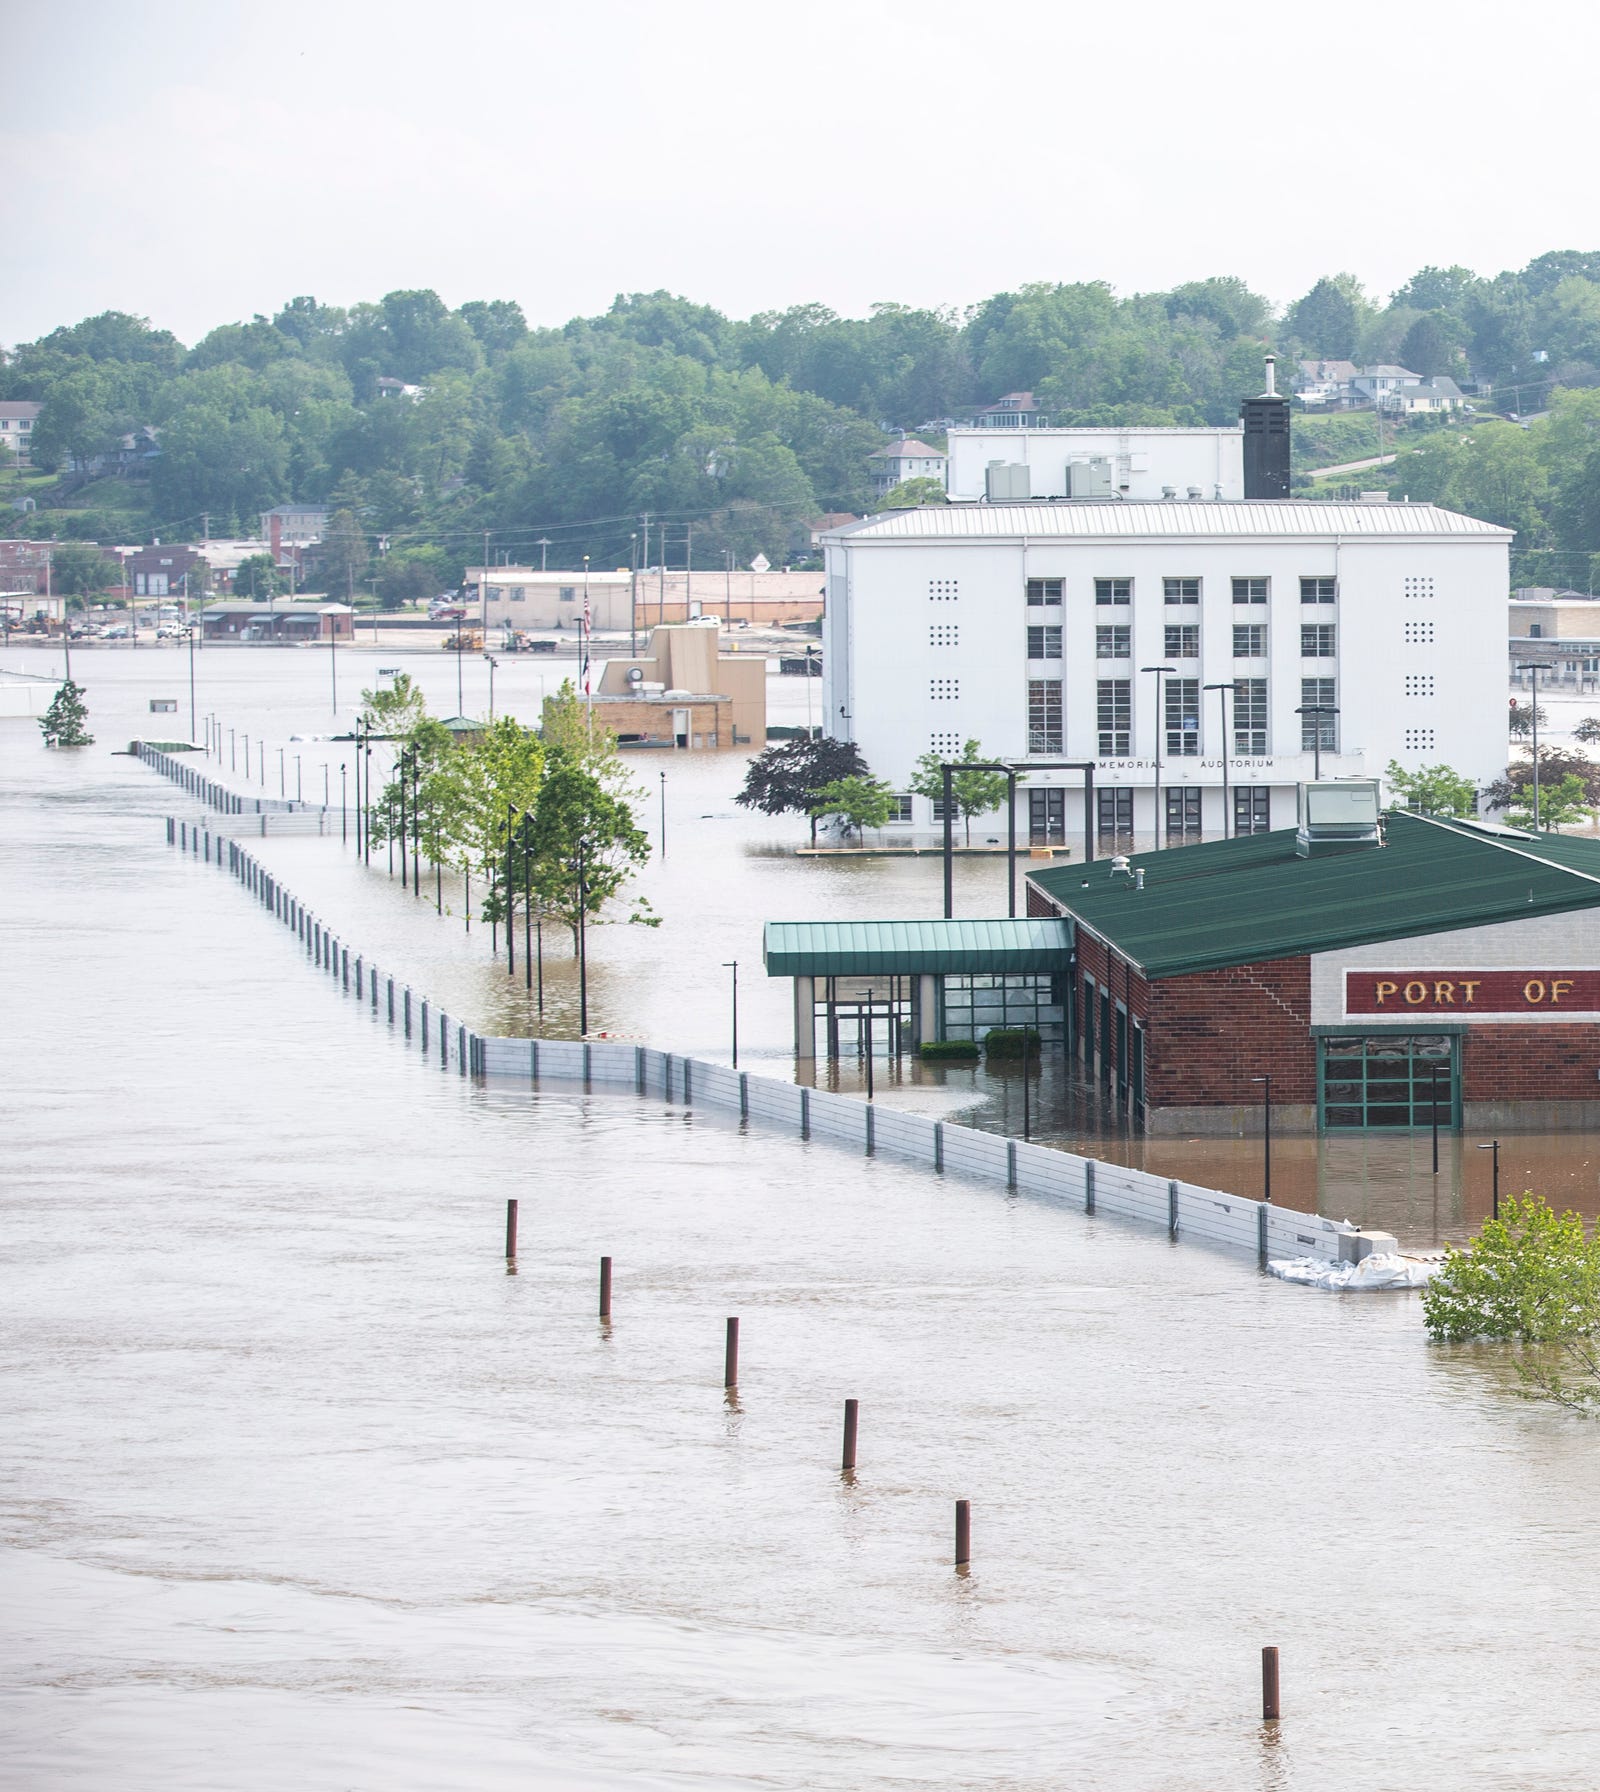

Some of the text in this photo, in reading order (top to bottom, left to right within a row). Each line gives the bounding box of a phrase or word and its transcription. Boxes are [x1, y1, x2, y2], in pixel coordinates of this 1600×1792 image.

[1099, 760, 1274, 769] MEMORIAL AUDTORIUM
[1376, 980, 1482, 1004] PORT
[1523, 979, 1575, 1003] OF
